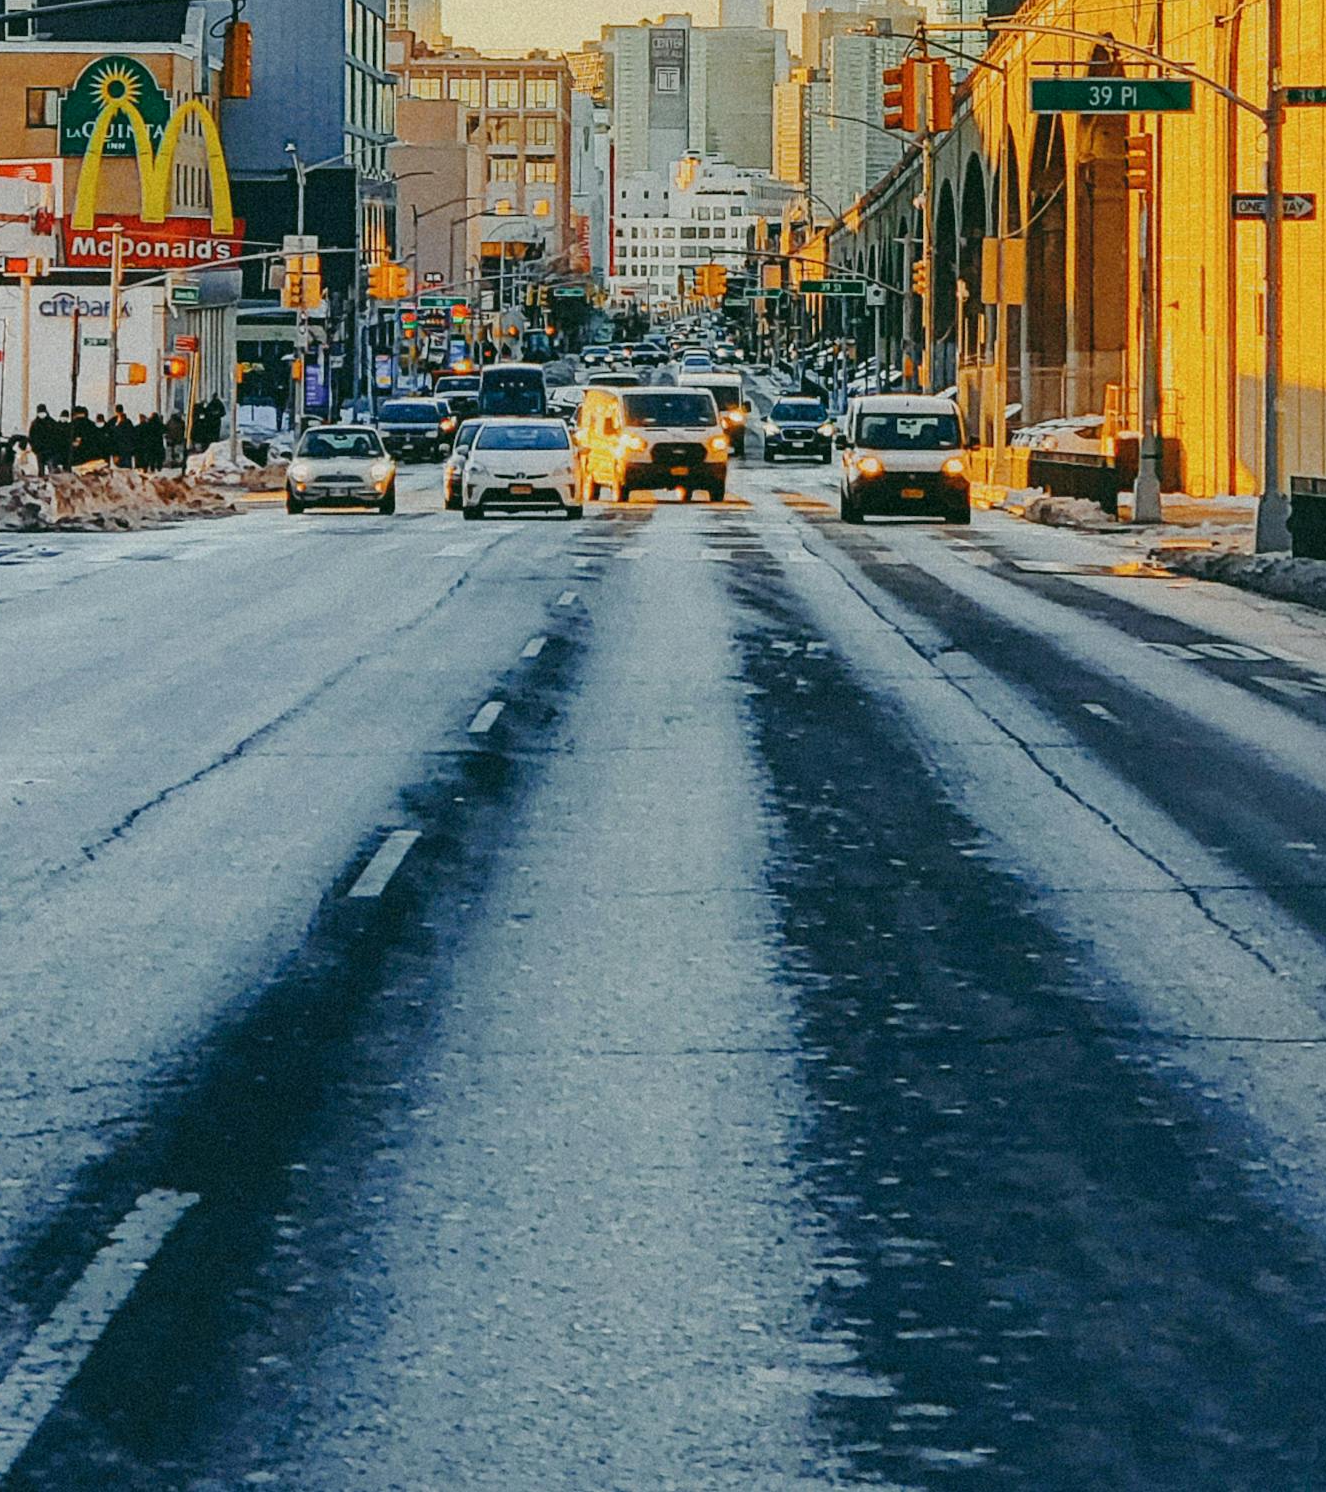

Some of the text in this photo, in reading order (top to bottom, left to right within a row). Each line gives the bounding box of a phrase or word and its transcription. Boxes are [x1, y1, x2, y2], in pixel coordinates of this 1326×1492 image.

[1089, 86, 1112, 106] 39
[1239, 202, 1264, 212] ONE
[71, 236, 231, 259] McDonald's
